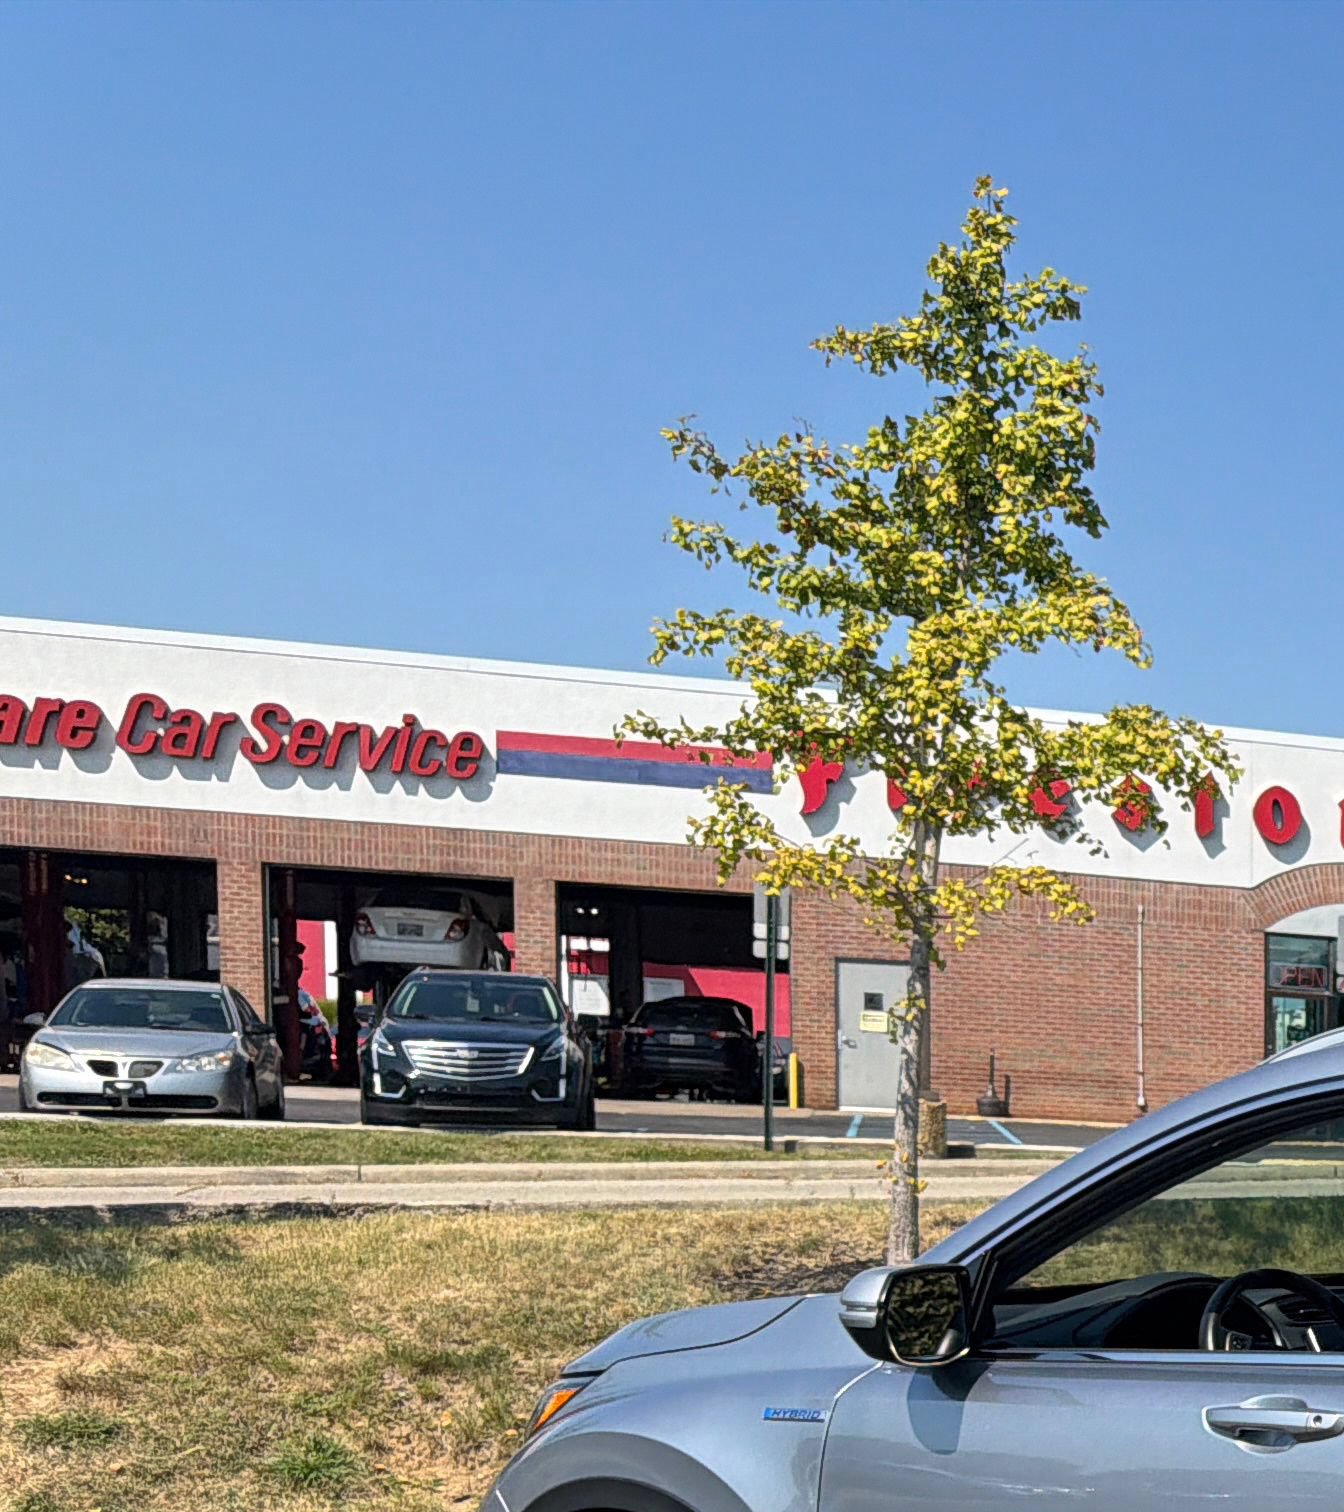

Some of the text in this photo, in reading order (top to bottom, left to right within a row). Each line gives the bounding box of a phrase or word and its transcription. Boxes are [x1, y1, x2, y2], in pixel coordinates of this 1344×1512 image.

[116, 693, 238, 760] Car
[240, 702, 485, 780] Service
[1276, 965, 1325, 988] PEN
[770, 1408, 822, 1420] HYBRID
